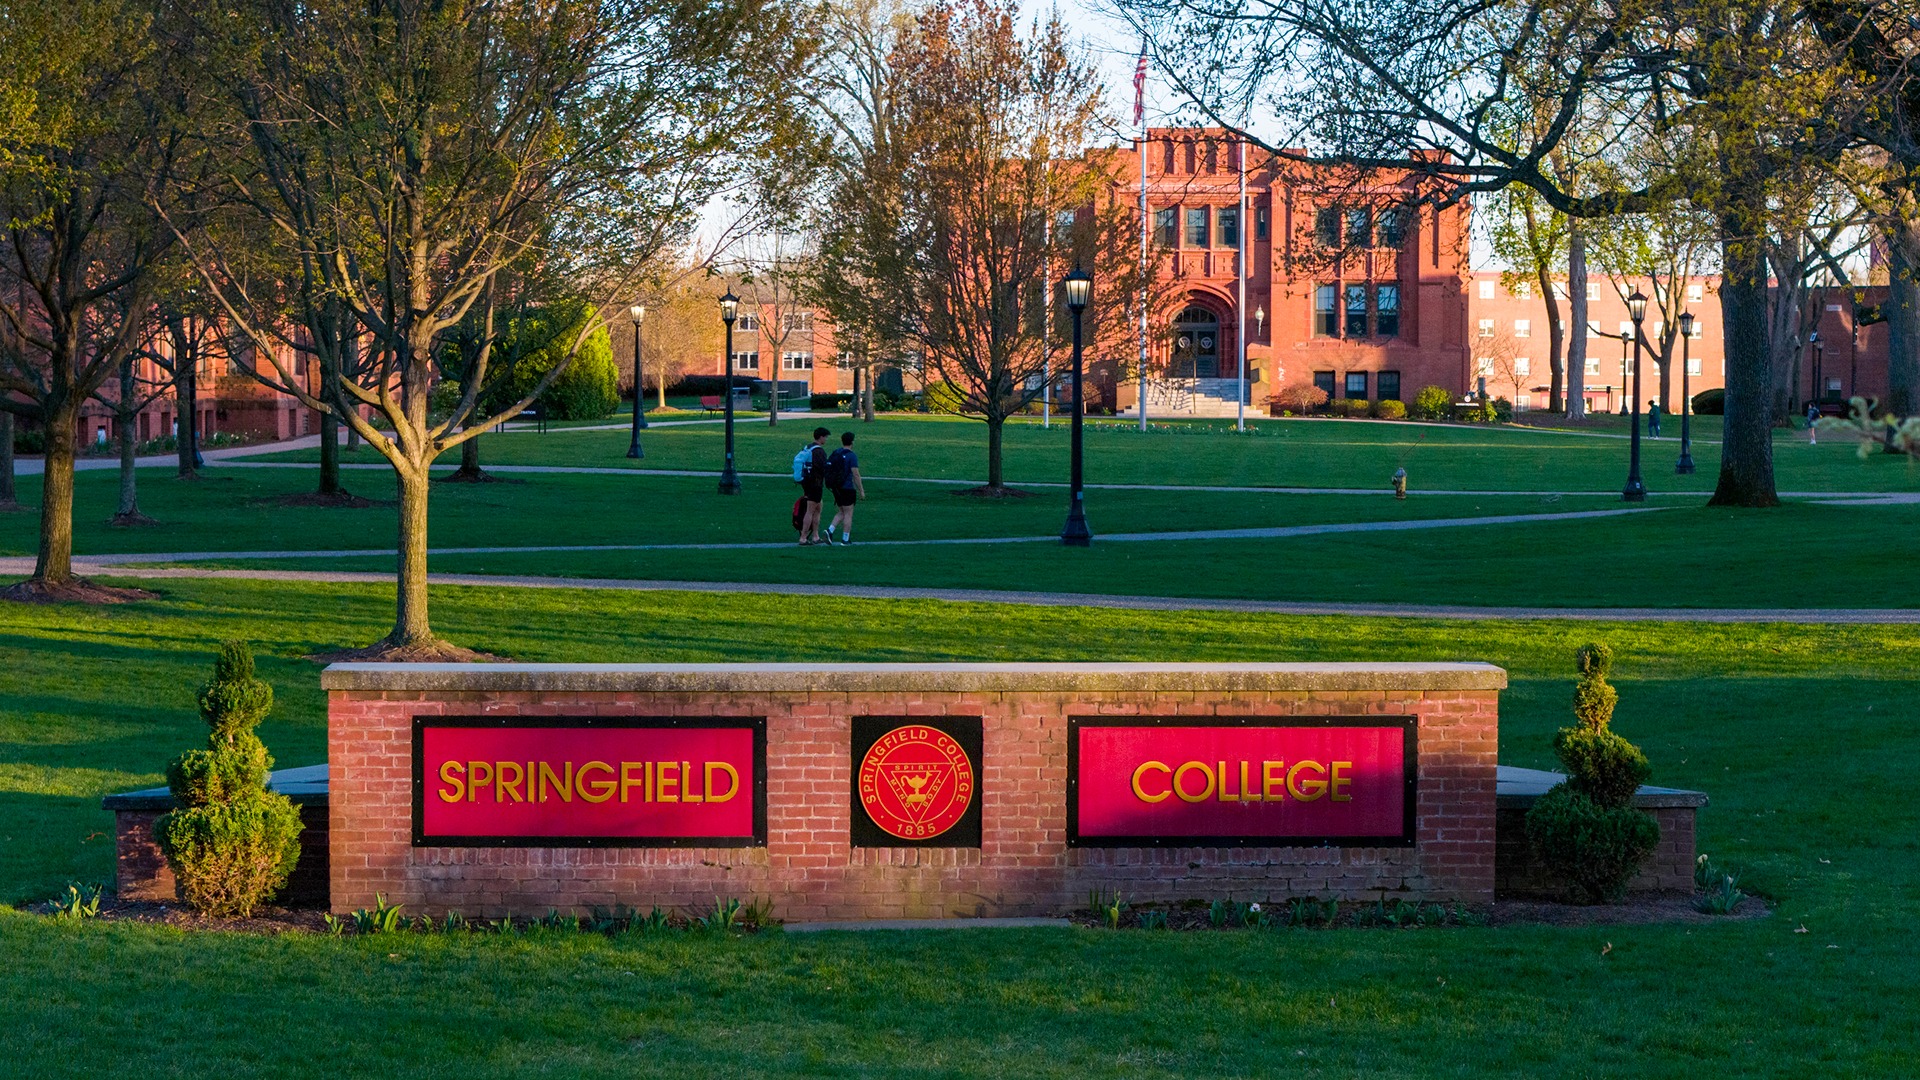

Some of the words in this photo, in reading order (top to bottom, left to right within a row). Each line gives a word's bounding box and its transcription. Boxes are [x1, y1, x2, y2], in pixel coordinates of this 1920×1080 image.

[438, 760, 739, 803] SPRINGFIELD
[863, 729, 928, 804] SPRINGFIELD
[937, 737, 969, 804] COLLEGE
[1131, 760, 1352, 803] COLLEGE
[890, 779, 910, 808] MIND
[897, 823, 936, 836] 1885
